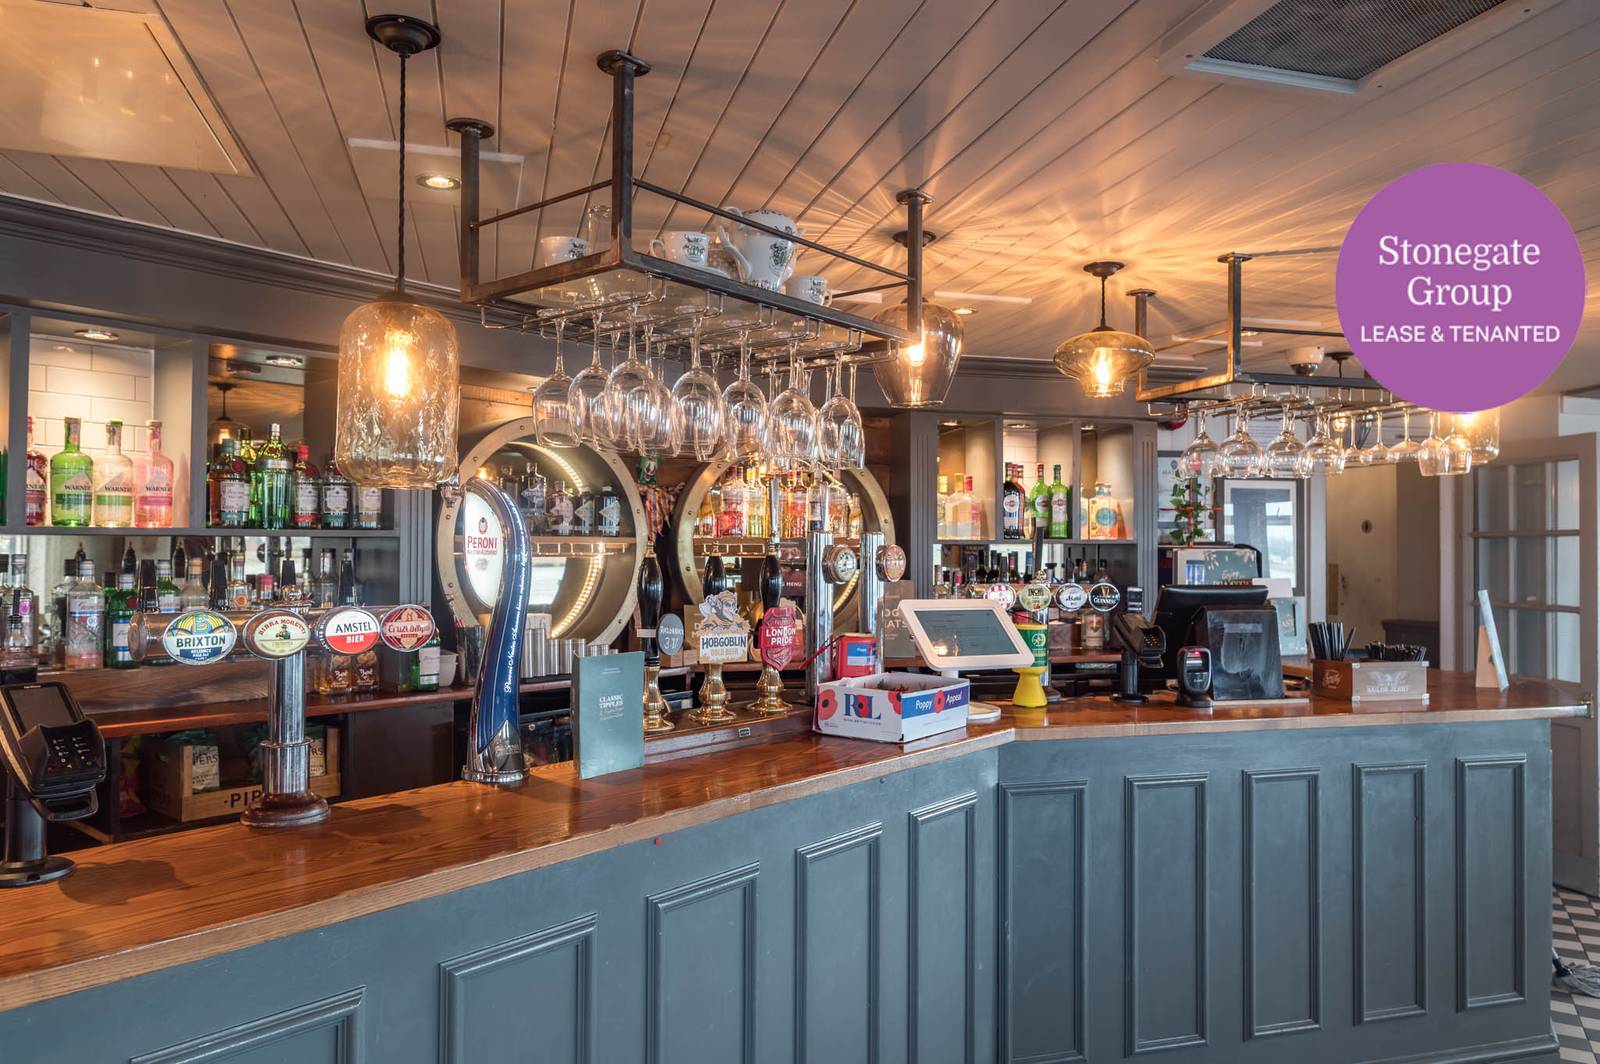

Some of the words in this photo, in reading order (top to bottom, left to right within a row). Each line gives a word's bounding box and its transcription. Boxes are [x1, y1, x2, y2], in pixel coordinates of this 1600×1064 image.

[467, 536, 497, 549] PERONI
[1093, 597, 1117, 605] GUINNESS
[258, 620, 280, 636] BIRRA
[280, 619, 306, 635] MORETTI
[335, 621, 373, 634] AMSTEL
[765, 627, 796, 638] LONDON
[176, 635, 226, 648] BRIXTON
[346, 635, 365, 644] BIER
[701, 636, 747, 650] HOBGOBLIN
[770, 636, 793, 646] PRIDE
[599, 694, 624, 703] CLASSIC
[915, 699, 933, 711] Poppy
[946, 690, 962, 705] Appeal
